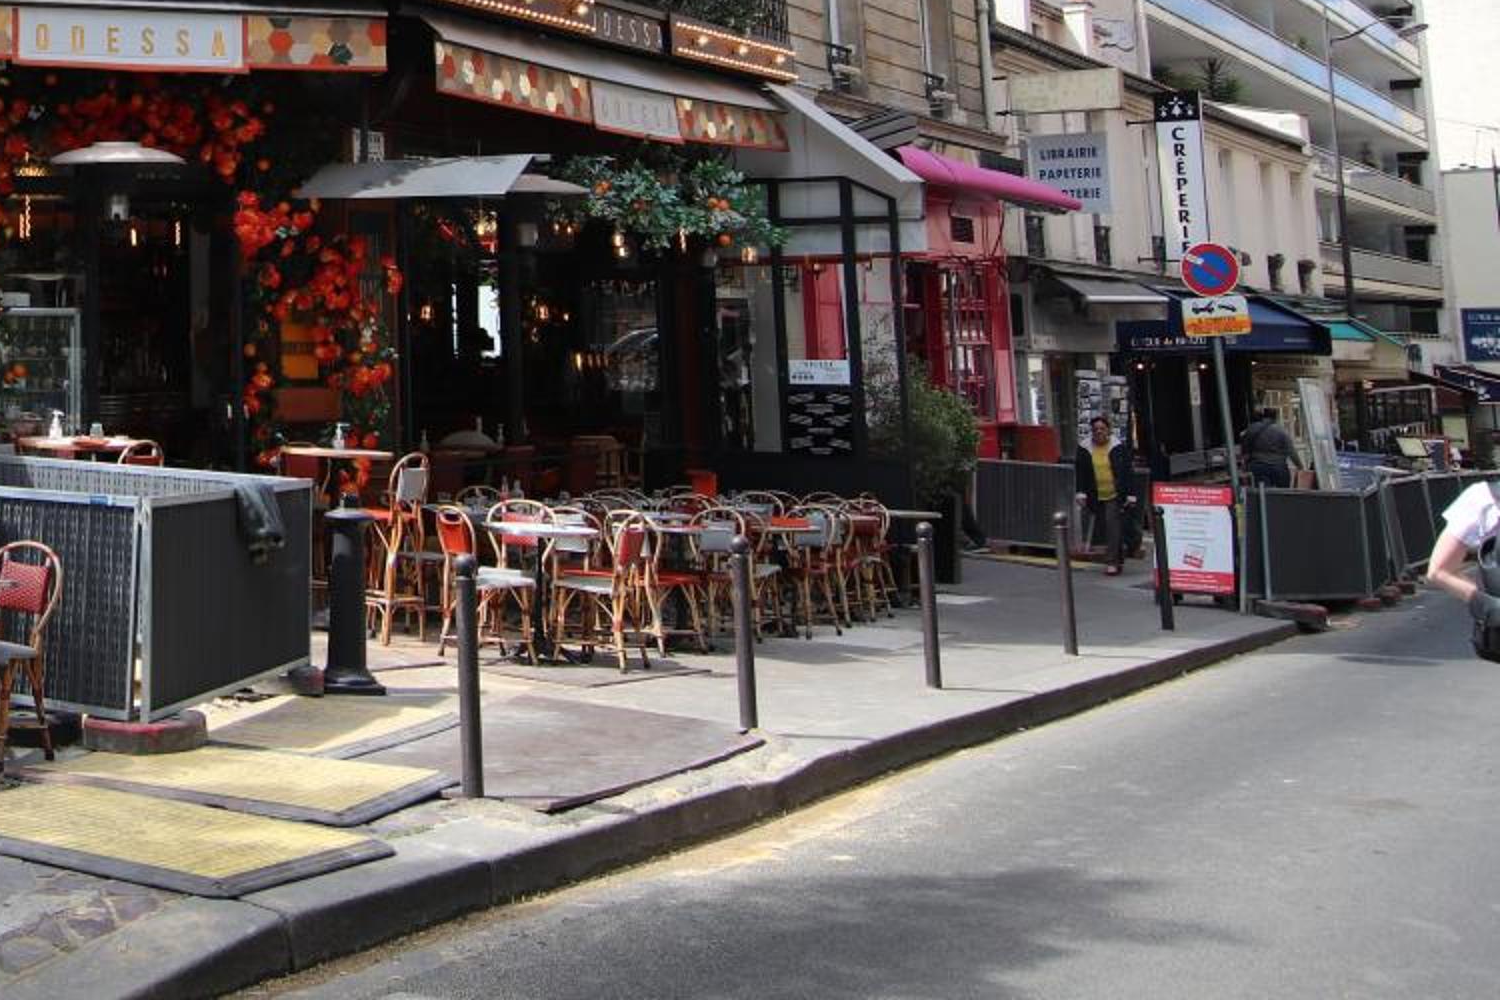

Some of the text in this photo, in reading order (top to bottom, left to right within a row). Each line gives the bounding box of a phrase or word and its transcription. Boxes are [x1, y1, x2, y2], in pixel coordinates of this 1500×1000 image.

[35, 23, 226, 57] ODESSA
[1039, 146, 1098, 161] LIBRAIRIE
[1038, 166, 1102, 181] PAPETERIE
